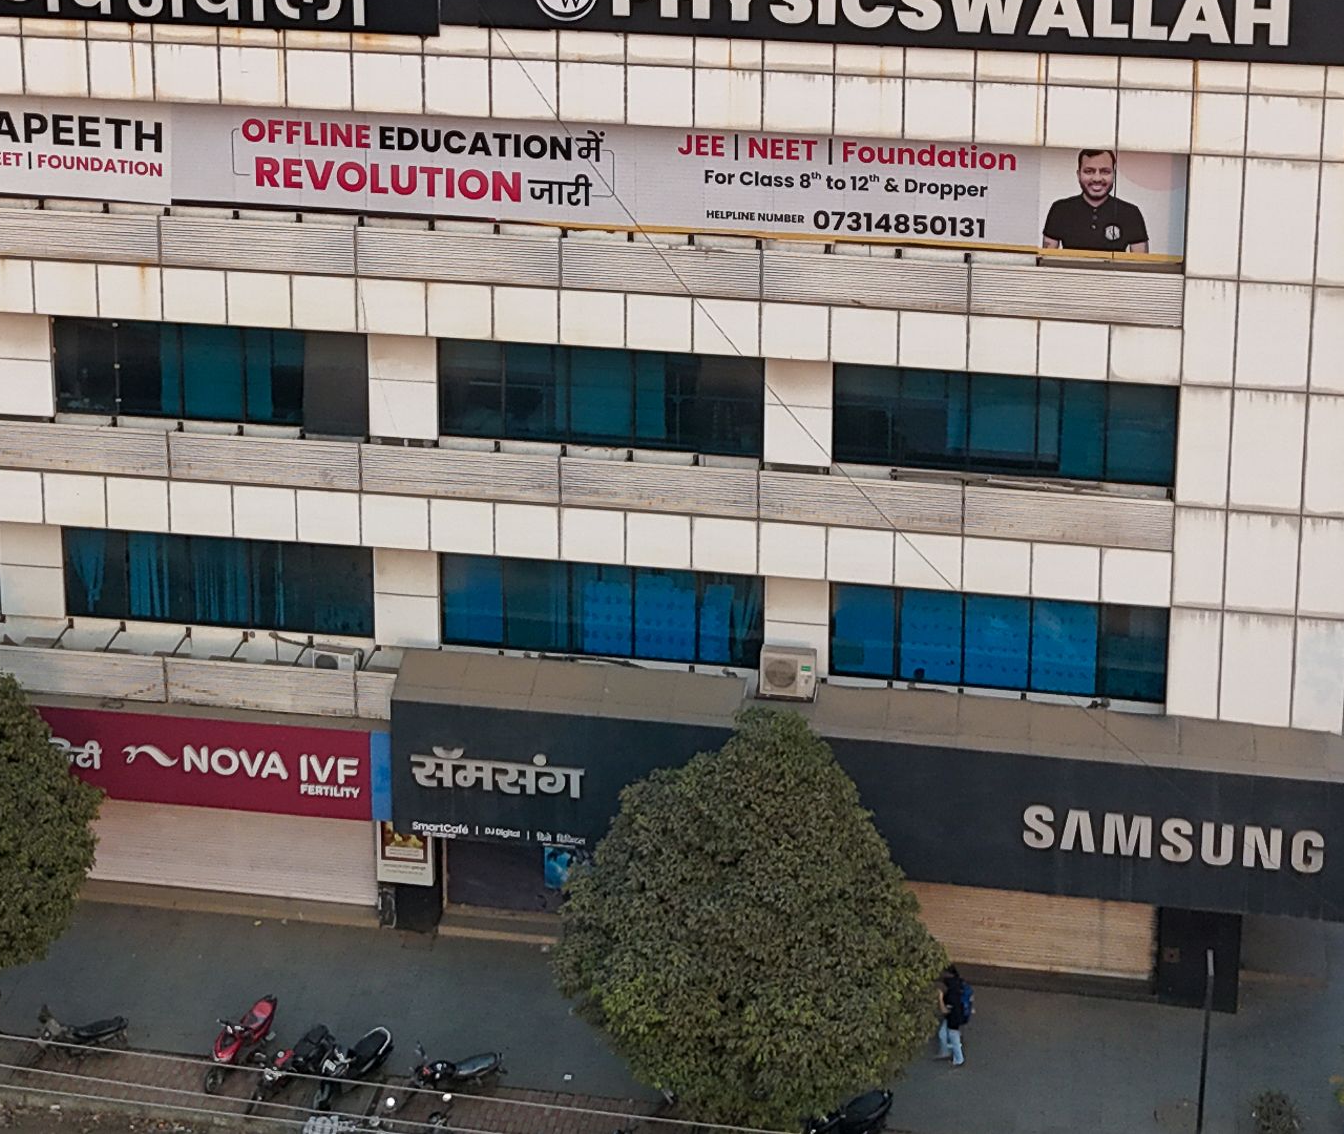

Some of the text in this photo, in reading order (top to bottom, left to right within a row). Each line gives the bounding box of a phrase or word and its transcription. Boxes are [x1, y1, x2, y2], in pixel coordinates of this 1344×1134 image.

[241, 118, 607, 163] OFFLINE EDUCATION में
[677, 134, 1018, 172] JEE NEET Foundation
[37, 153, 163, 178] FOUNDATION
[254, 155, 593, 207] REVOLUTION जारी
[704, 169, 736, 186] For
[739, 170, 795, 189] Class
[826, 174, 846, 191] to
[883, 177, 900, 193] &
[904, 177, 989, 201] Dropper
[706, 209, 987, 239] HELPLINE NUMBER 07314850131
[182, 744, 360, 785] NOVA IVF
[300, 783, 361, 798] FERTILITY
[1022, 804, 1326, 874] SAMSUNG
